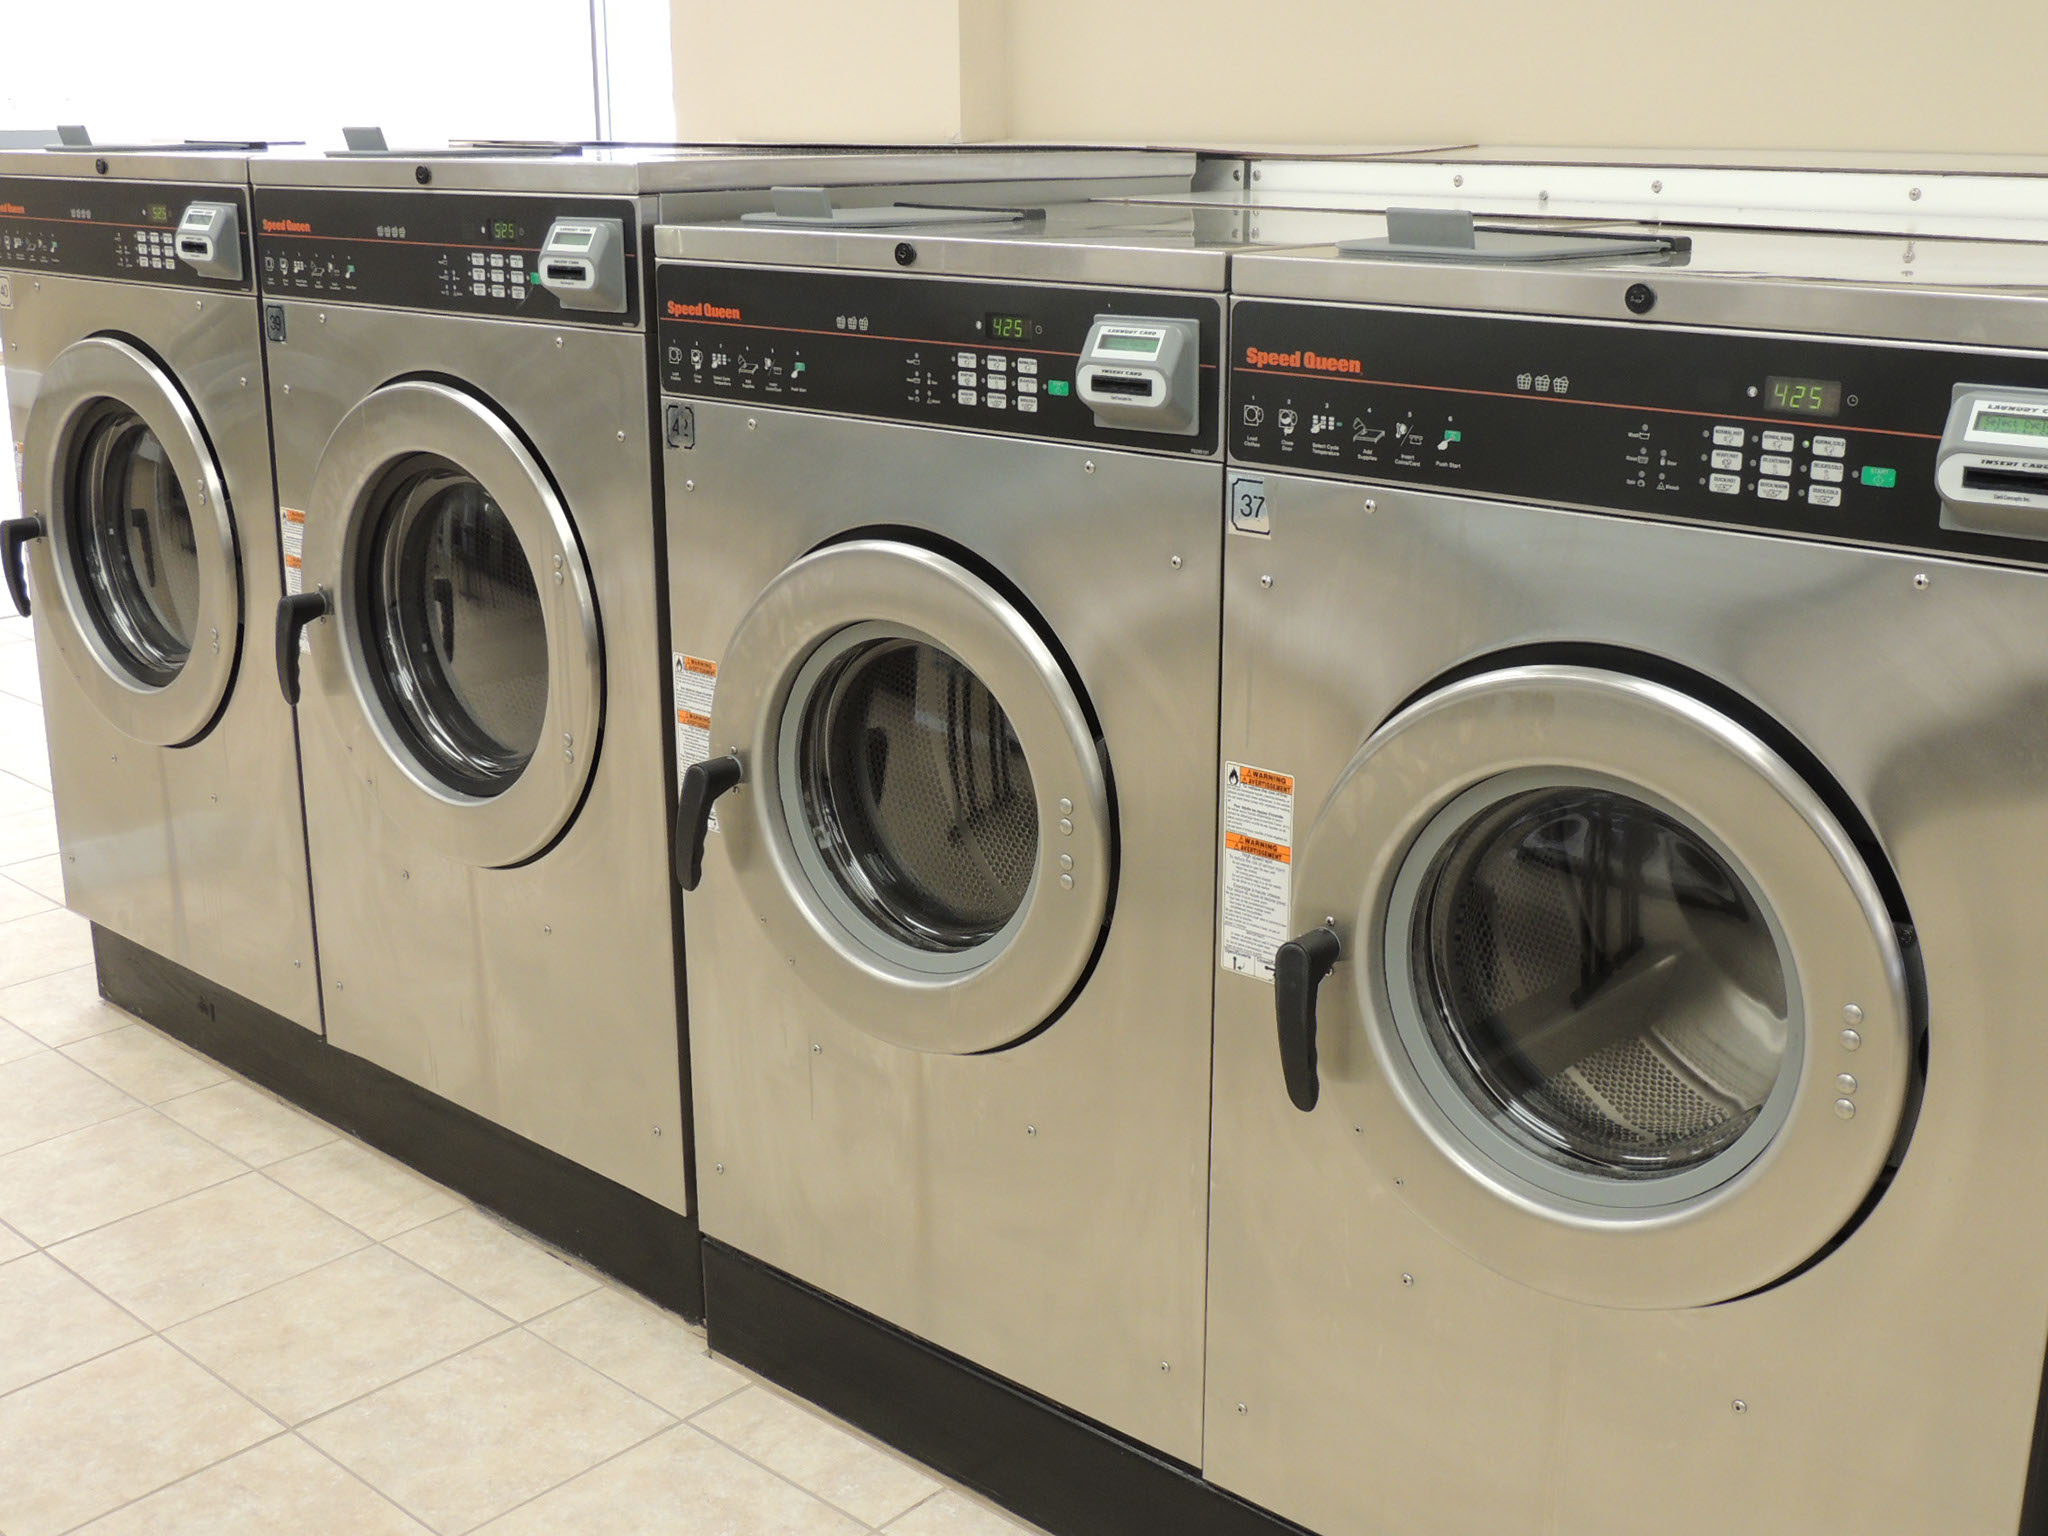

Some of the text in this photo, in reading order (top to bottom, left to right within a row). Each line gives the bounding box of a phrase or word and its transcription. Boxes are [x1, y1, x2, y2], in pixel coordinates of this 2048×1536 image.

[263, 219, 286, 232] Speed
[495, 223, 514, 238] 525
[667, 300, 740, 319] Speed Queen
[993, 318, 1022, 337] 425
[1246, 347, 1361, 373] Speed Queen
[1775, 384, 1823, 409] 425
[1987, 404, 2039, 413] LAUNDRY
[1981, 459, 2018, 467] INSERT
[1240, 494, 1265, 518] 37
[1252, 771, 1287, 784] WARNING
[1245, 837, 1277, 851] WARNING
